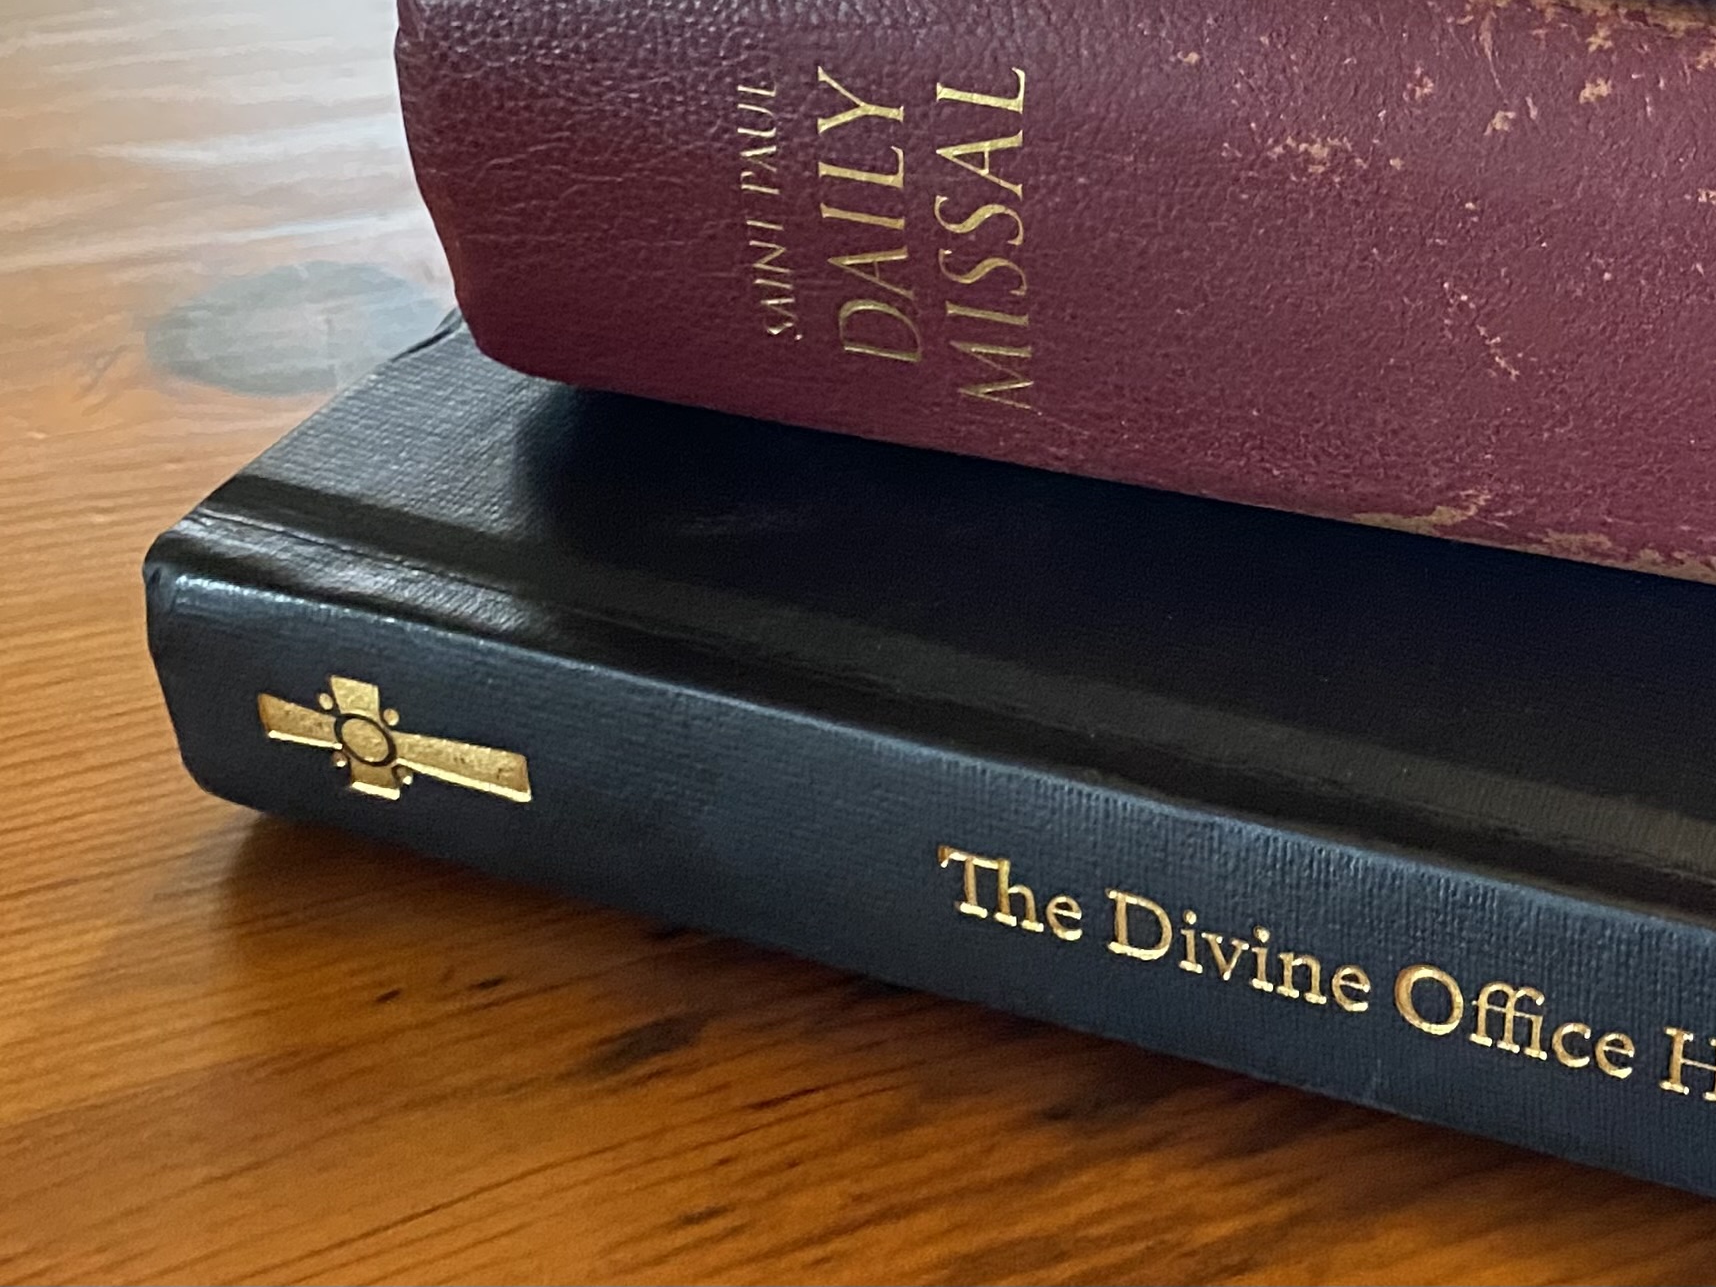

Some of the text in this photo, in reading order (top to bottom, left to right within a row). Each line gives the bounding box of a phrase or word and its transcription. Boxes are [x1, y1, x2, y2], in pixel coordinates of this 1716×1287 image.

[817, 65, 922, 364] DAILY
[934, 66, 1043, 416] MISSAL
[938, 844, 1083, 941] The
[1105, 887, 1372, 1013] Divine
[1395, 964, 1636, 1080] Office
